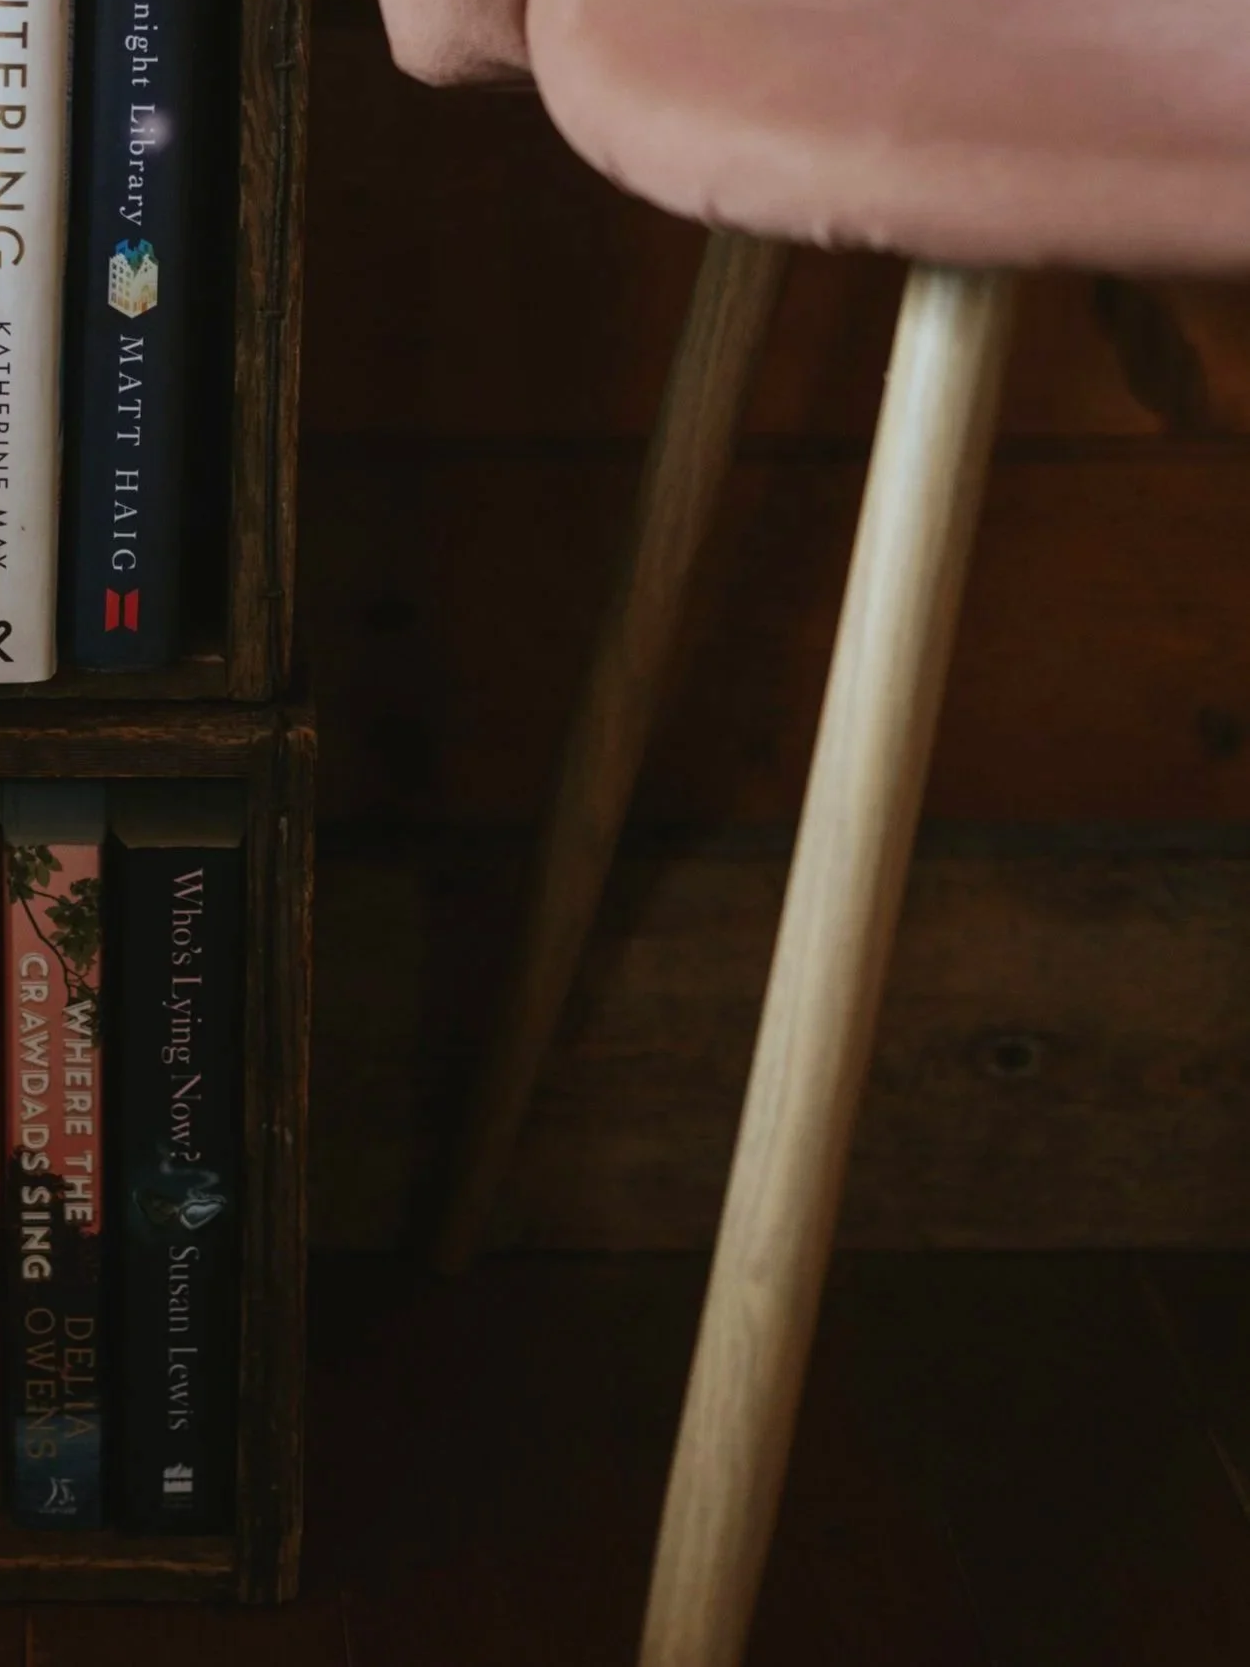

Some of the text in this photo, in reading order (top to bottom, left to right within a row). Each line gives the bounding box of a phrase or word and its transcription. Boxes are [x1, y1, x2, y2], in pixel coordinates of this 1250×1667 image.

[118, 103, 155, 227] Library
[117, 333, 144, 447] MATT
[111, 468, 139, 574] HAIG
[19, 952, 51, 1280] CRAWDADS SING
[62, 999, 94, 1229] WHERE THE
[161, 867, 204, 1431] Who's Lying Now? Susan Lewis
[24, 1307, 56, 1460] OWENS
[63, 1317, 96, 1439] DELIA
